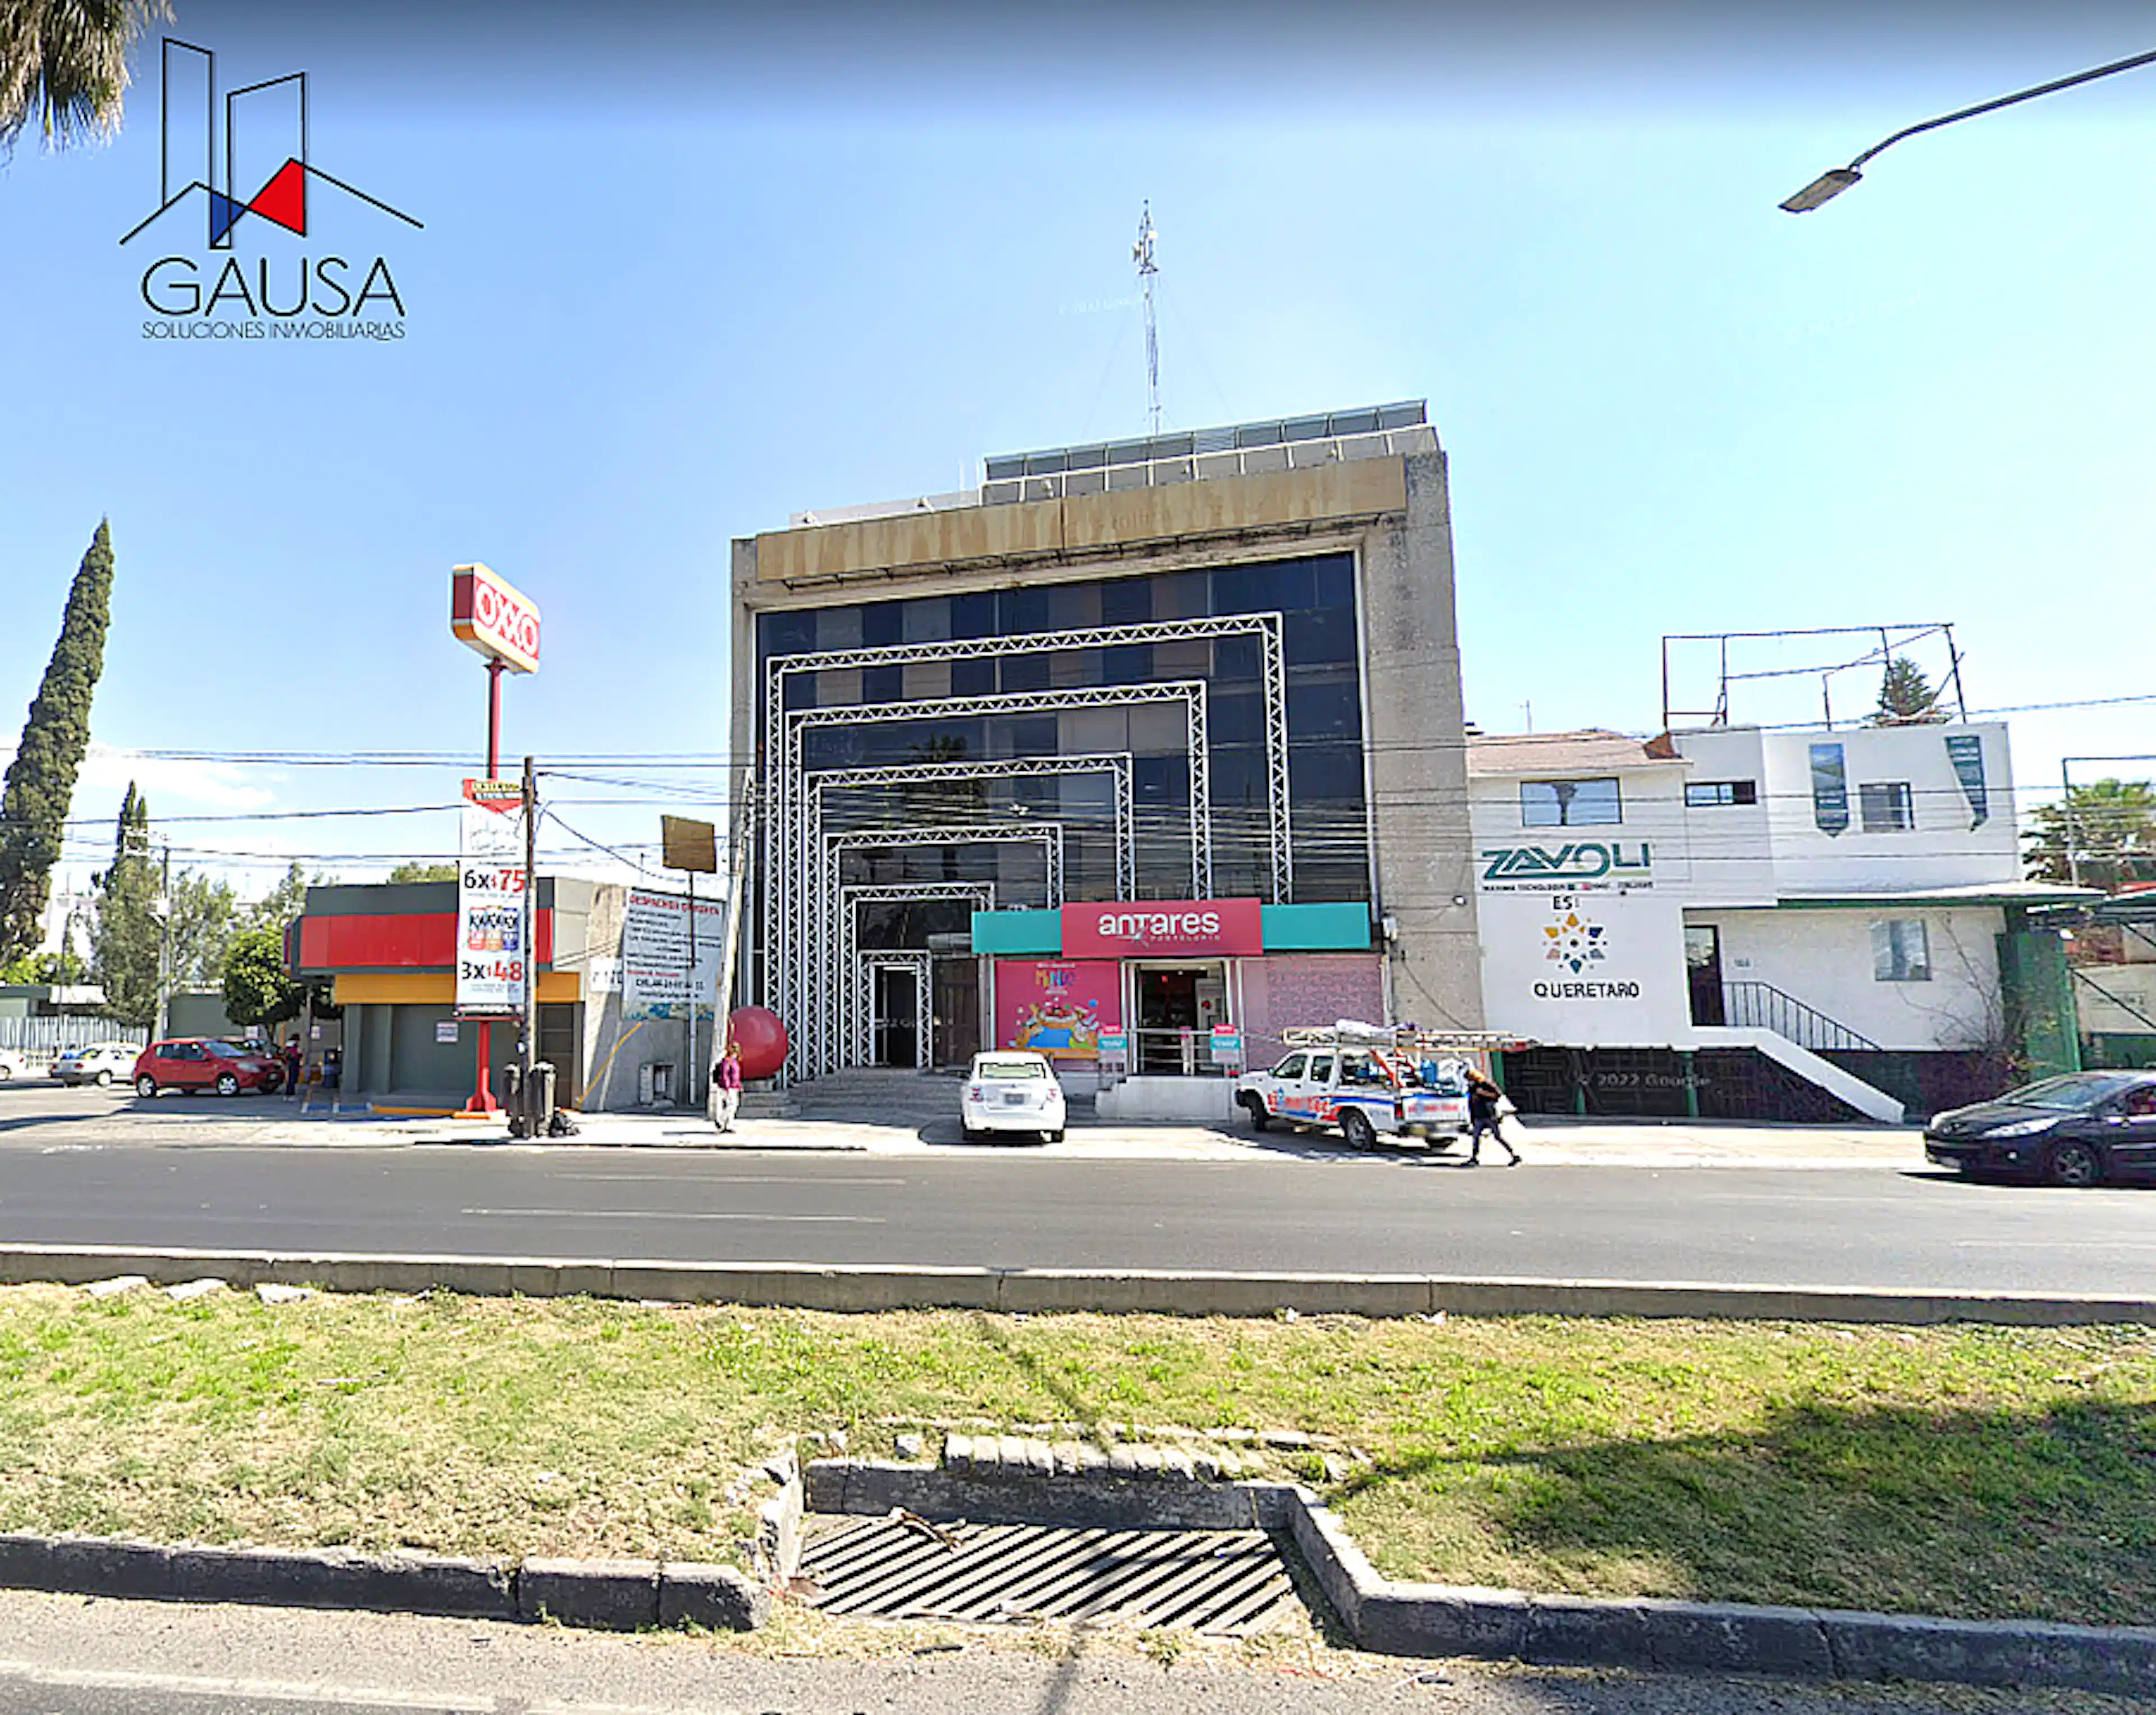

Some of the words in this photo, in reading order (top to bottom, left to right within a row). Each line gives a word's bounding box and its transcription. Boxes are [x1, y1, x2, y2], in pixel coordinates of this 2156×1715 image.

[477, 582, 537, 656] OXXO
[1482, 843, 1651, 880] ZAVOLI
[1534, 983, 1640, 998] QUERETARO
